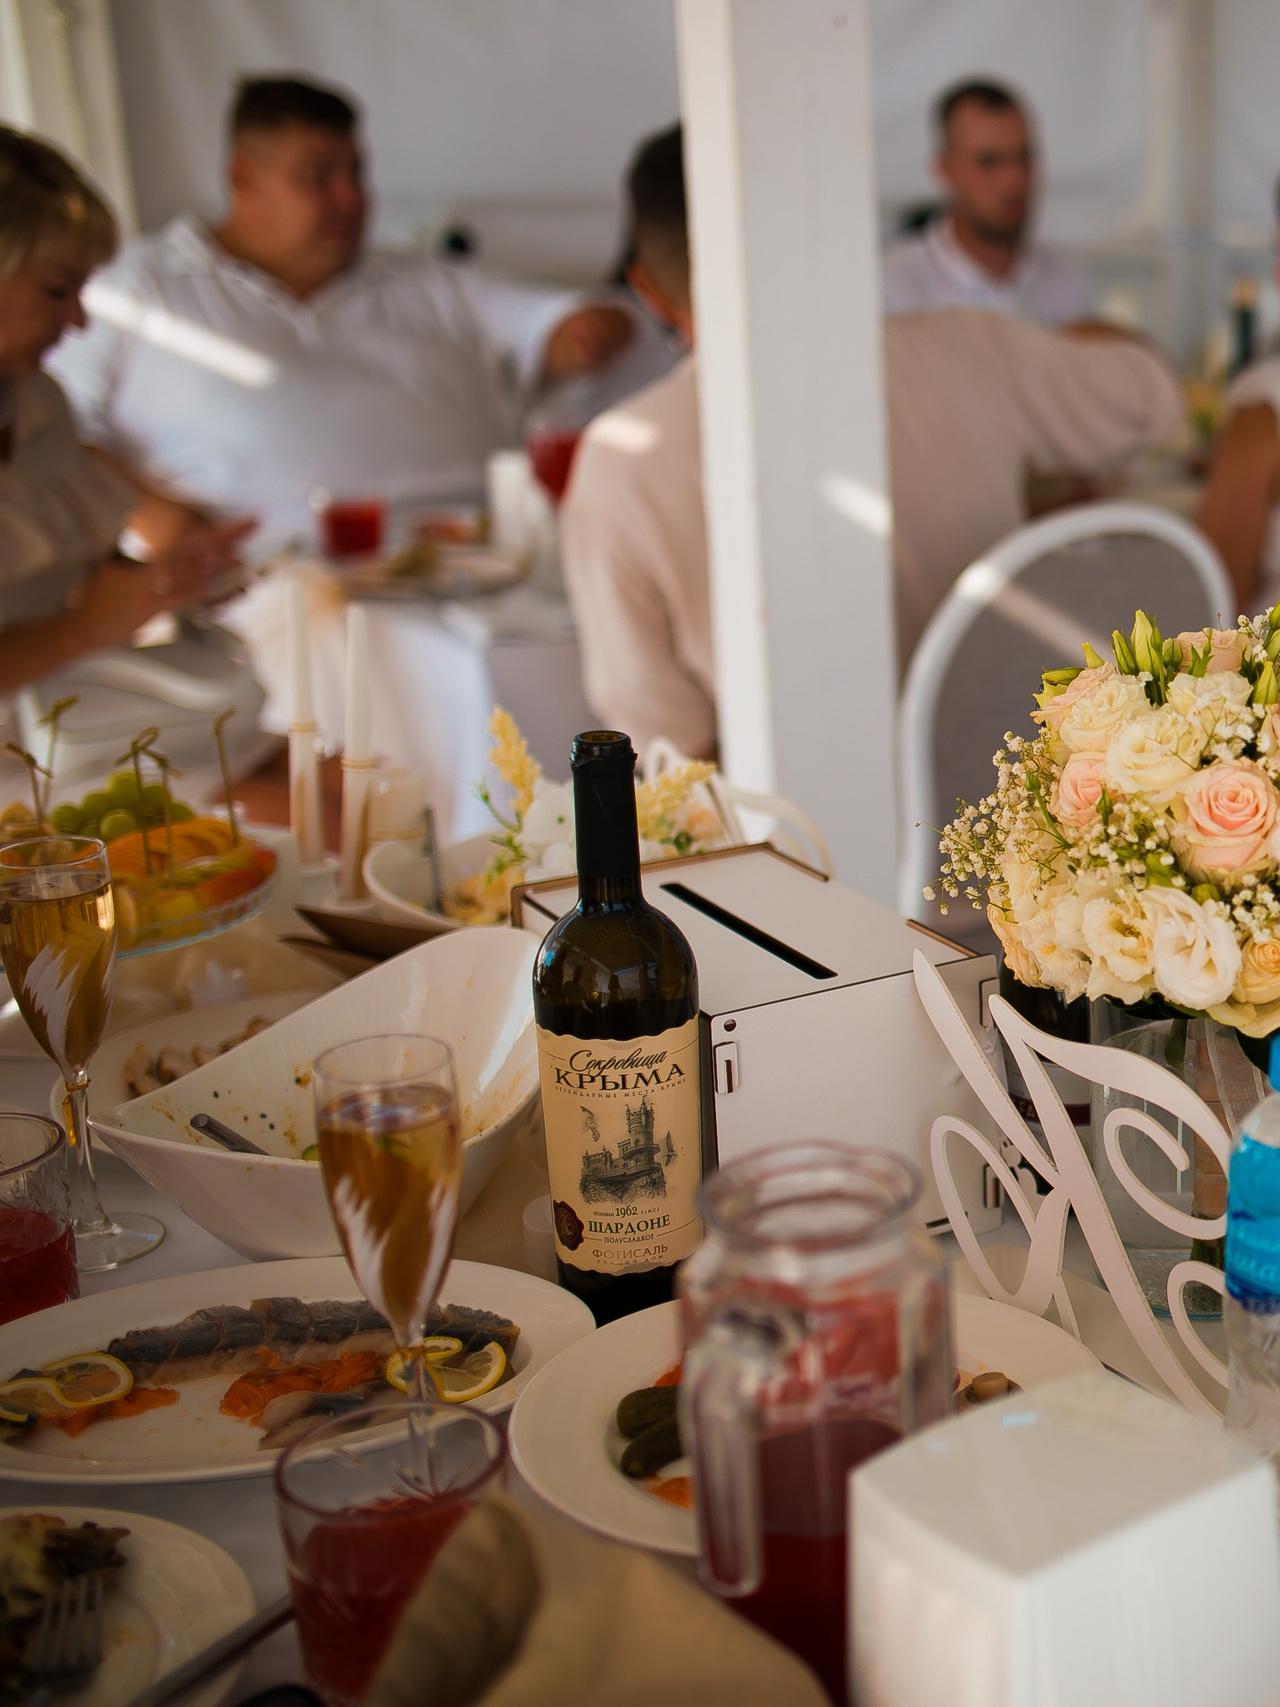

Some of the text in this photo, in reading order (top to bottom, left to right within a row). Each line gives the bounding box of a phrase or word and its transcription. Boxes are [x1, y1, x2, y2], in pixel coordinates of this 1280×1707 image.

[569, 1047, 668, 1078] Сокровища
[554, 1063, 686, 1091] КРЫМА
[555, 1078, 686, 1099] ЛЕГЕНДАРНЫЕ МЕСТА КРЫМА
[615, 1205, 638, 1219] 1962
[588, 1214, 671, 1236] ШАРДОНЕ
[604, 1234, 654, 1244] ПОЛУСЛАДКОЕ
[592, 1244, 669, 1259] ФОТИСАЛЬ
